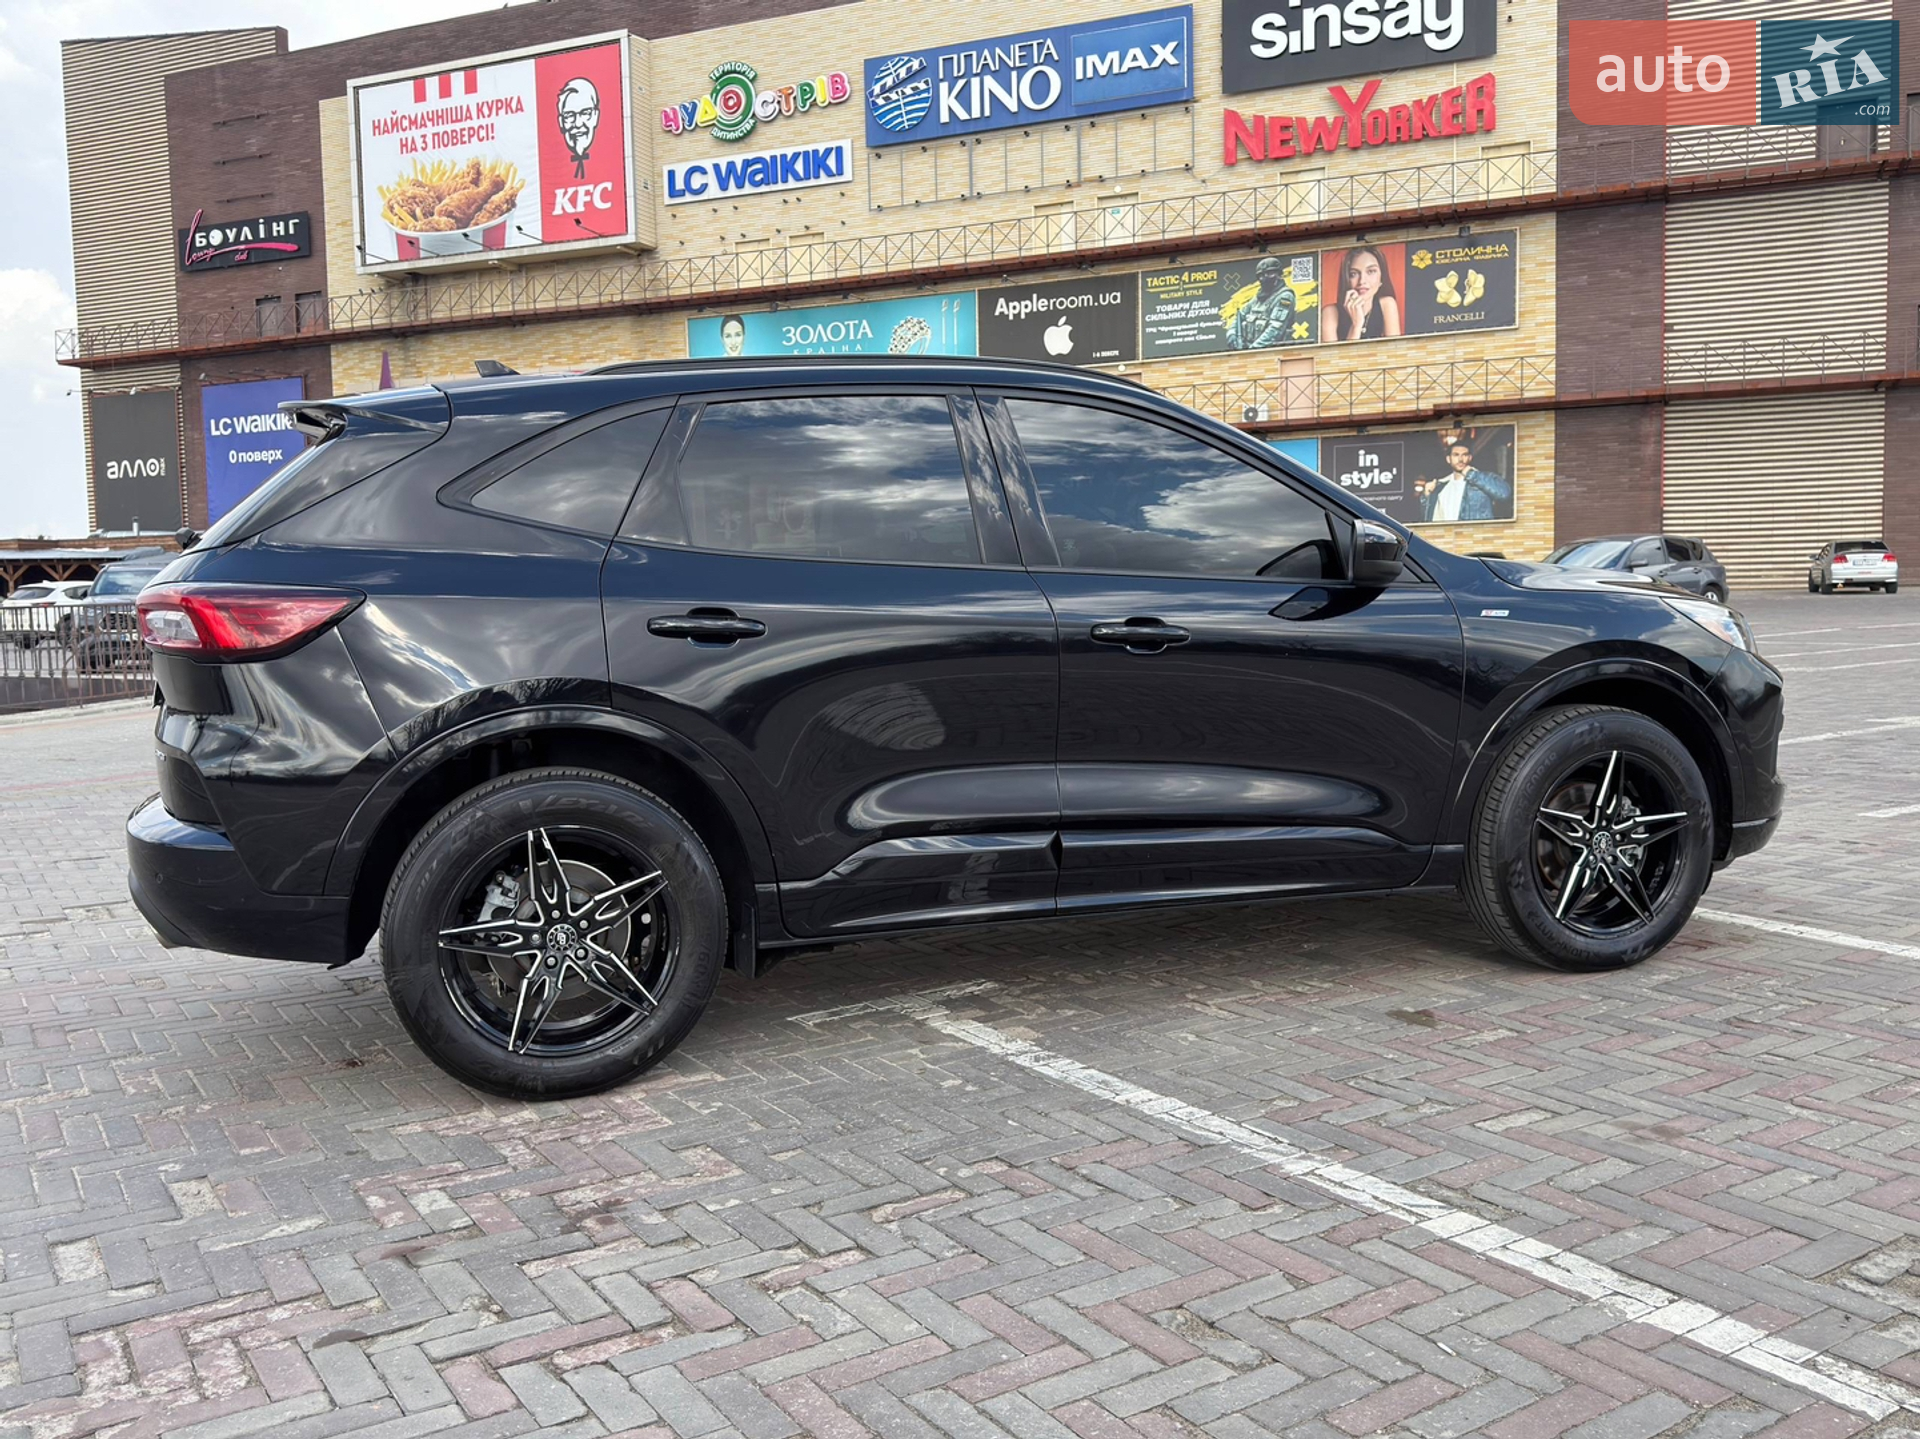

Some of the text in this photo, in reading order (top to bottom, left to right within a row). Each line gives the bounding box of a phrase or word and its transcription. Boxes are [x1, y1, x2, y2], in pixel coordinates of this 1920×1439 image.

[1075, 41, 1179, 80] IMAX
[372, 95, 524, 137] НАЙСМАЧНІША КУРКА
[400, 123, 496, 155] НА 3 ПОВЕРСІ!
[667, 166, 708, 199] LC
[552, 181, 613, 216] KFC
[1435, 243, 1509, 259] СТОЛИЧНА
[1146, 270, 1218, 287] TACTIC 4 PROFI
[1145, 307, 1219, 322] СИЛЬНИХ ДУХОМ
[1156, 300, 1210, 313] ТОВАРИ ДЛЯ
[1433, 311, 1485, 324] FRANCELLI
[782, 319, 874, 346] ЗОЛОТА
[210, 417, 232, 436] LC
[238, 449, 283, 464] поверх
[1358, 449, 1379, 467] in
